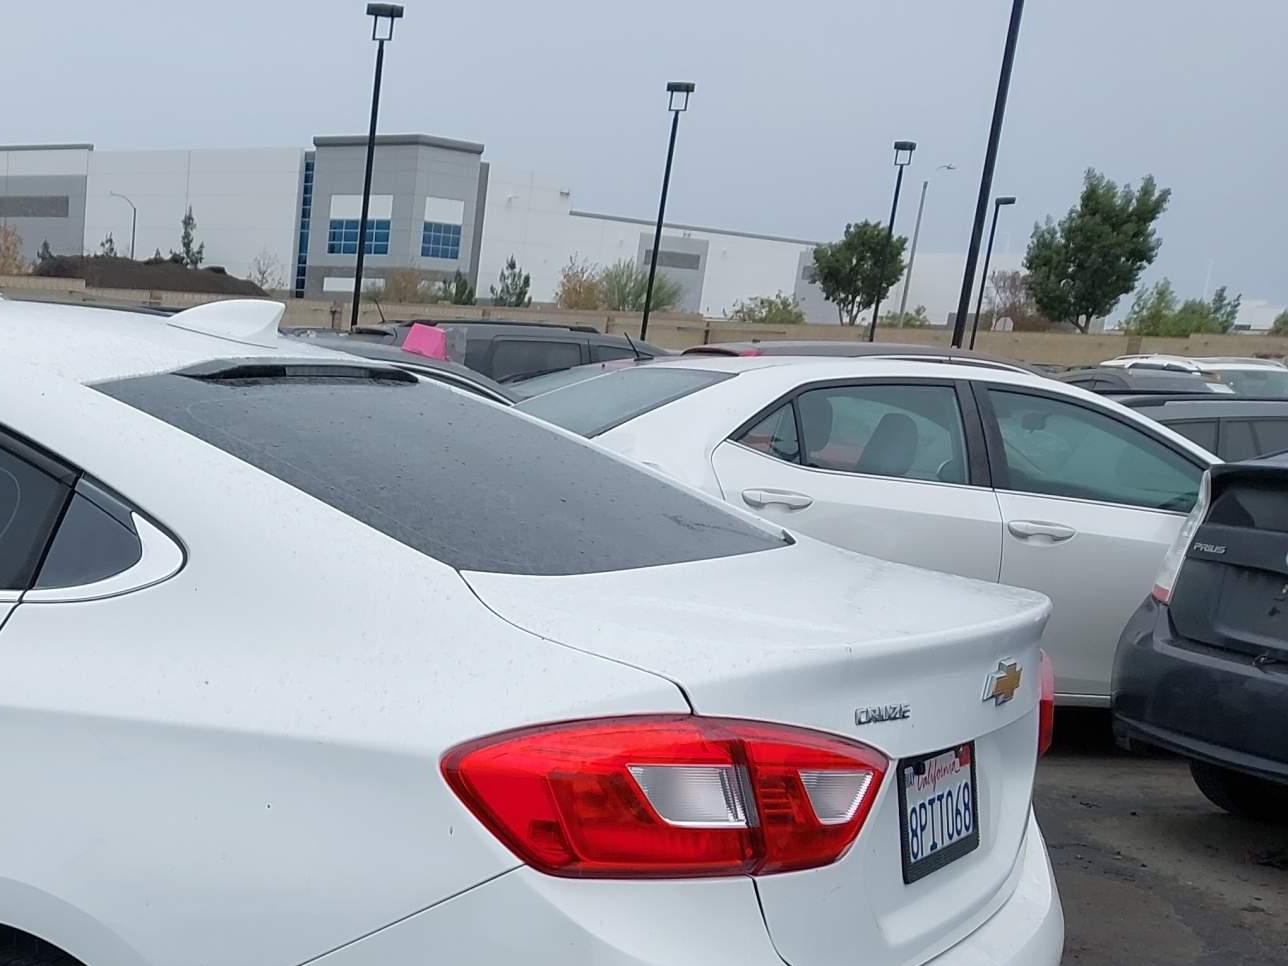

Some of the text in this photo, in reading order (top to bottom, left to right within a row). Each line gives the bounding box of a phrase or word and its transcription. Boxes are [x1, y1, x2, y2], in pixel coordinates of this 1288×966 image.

[1193, 542, 1227, 554] PRIUS
[855, 704, 911, 726] CRUZE
[909, 781, 972, 860] 8PIT068
